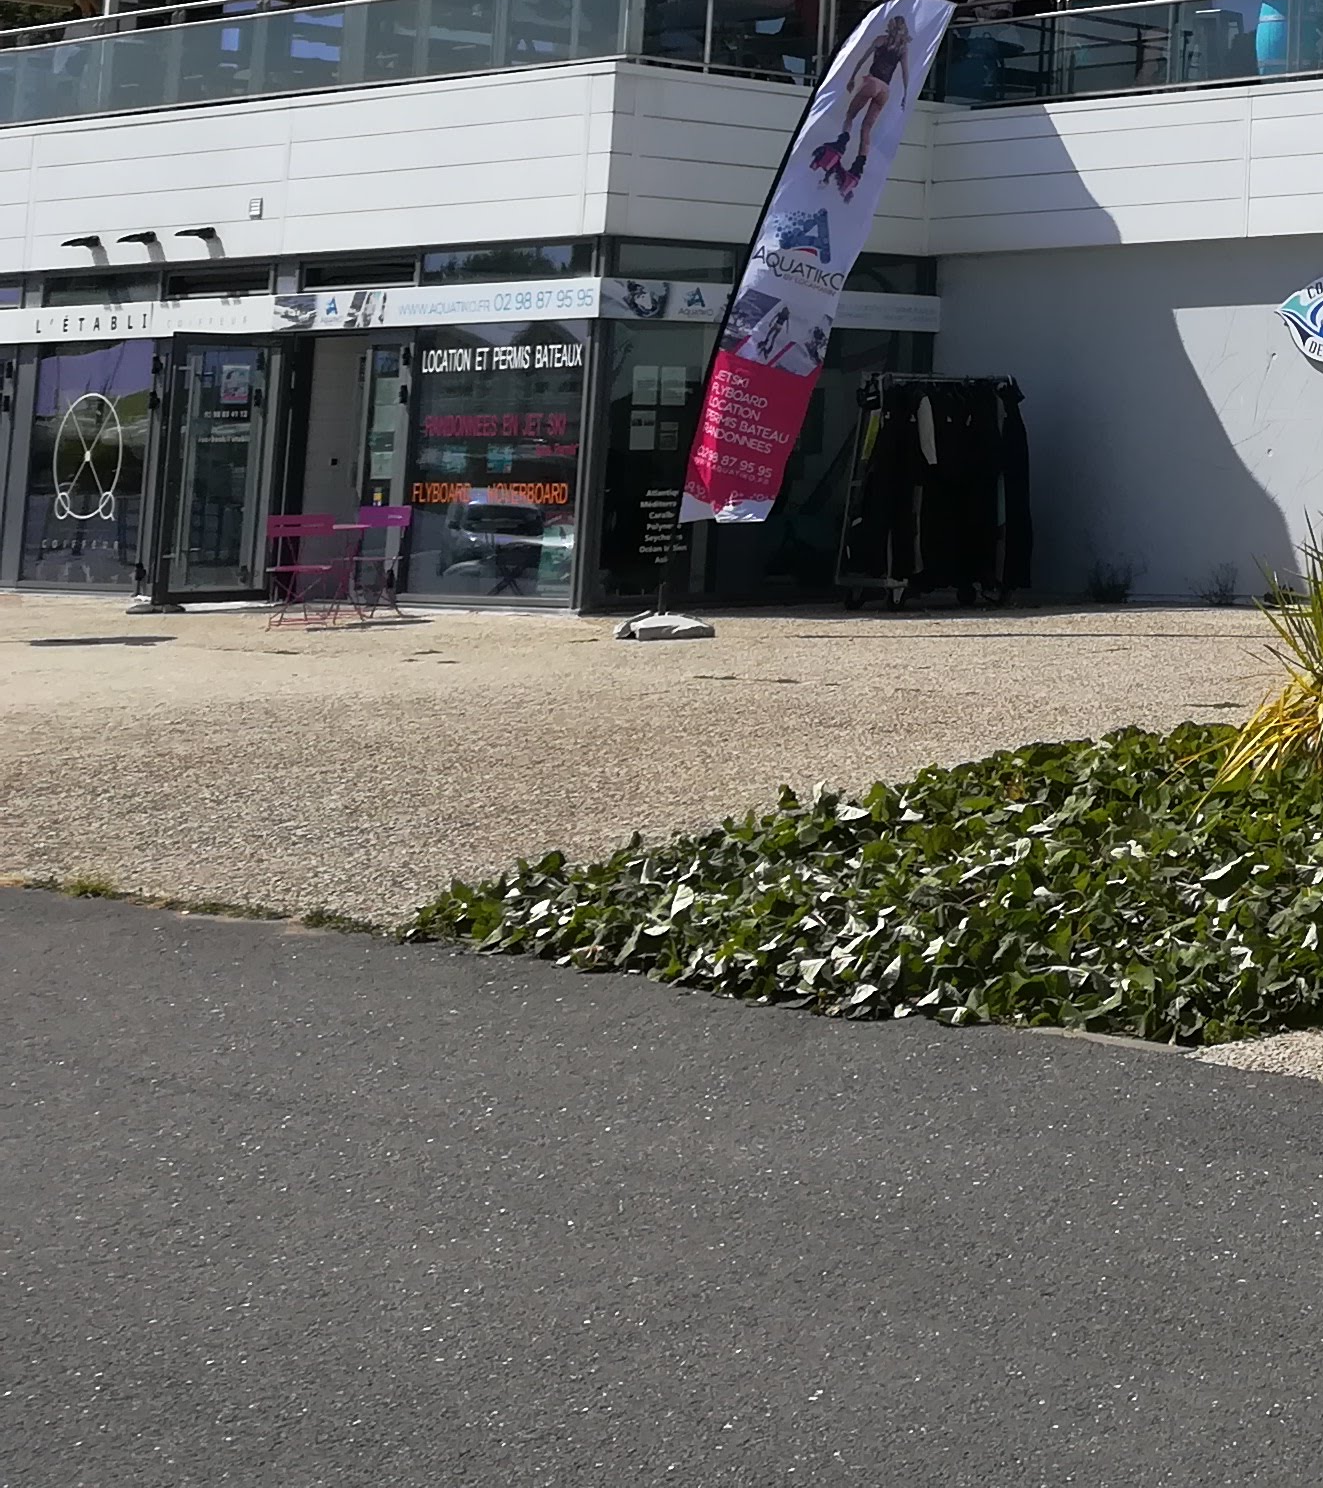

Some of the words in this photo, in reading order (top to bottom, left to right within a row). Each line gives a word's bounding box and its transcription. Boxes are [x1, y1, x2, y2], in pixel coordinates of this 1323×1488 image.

[494, 293, 512, 311] 02
[515, 292, 532, 310] 98
[536, 291, 553, 309] 87
[556, 290, 574, 308] 95
[577, 288, 594, 307] 95
[422, 348, 472, 373] LOCATION
[475, 347, 490, 371] ET
[492, 345, 531, 371] PERMIS
[534, 344, 583, 369] BATEAUX
[709, 395, 761, 421] LOCATION
[739, 421, 789, 444] BATEAU
[721, 455, 737, 467] 87
[740, 459, 755, 472] 95
[758, 465, 773, 478] 95
[412, 483, 472, 503] FLYBOARD
[487, 482, 569, 504] HOVERBOARD
